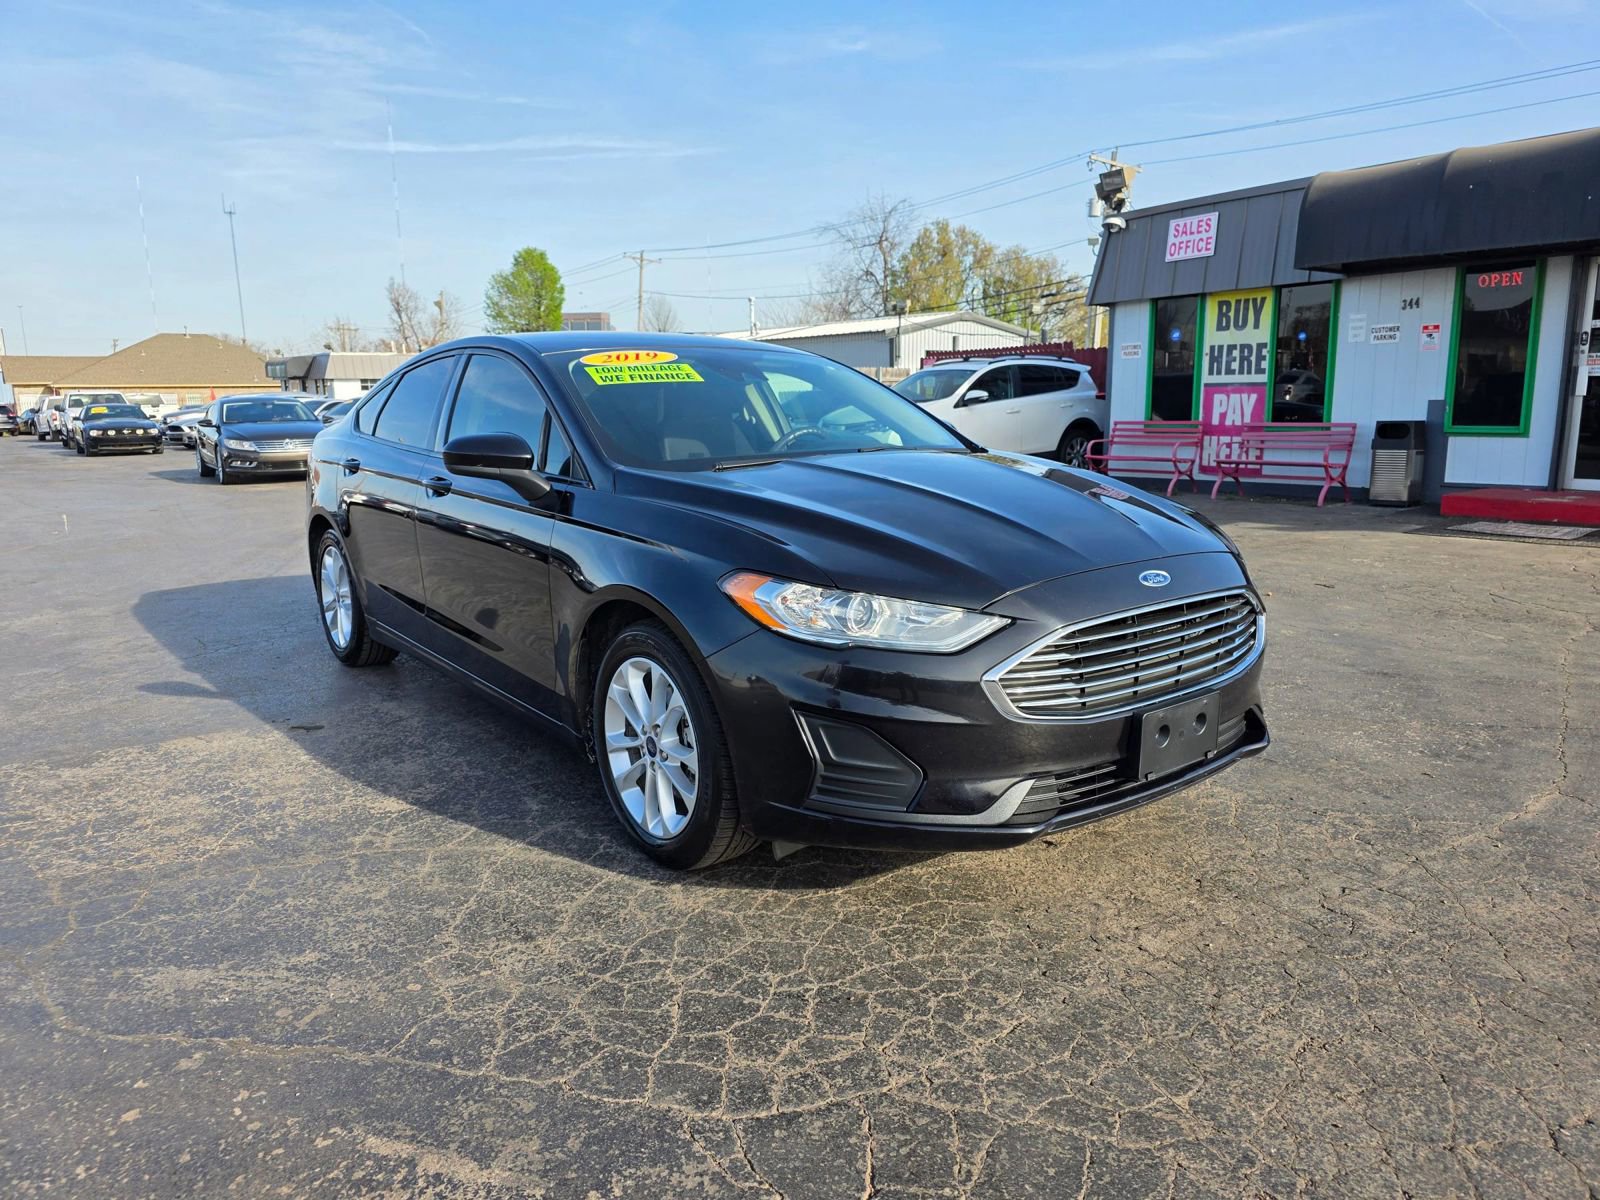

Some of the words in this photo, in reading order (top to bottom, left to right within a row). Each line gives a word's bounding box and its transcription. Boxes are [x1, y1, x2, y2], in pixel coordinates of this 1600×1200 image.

[1173, 217, 1212, 239] SALES
[1169, 236, 1213, 257] OFFICE
[1478, 271, 1524, 288] OPEN
[1401, 297, 1420, 311] 344
[1215, 296, 1268, 332] BUY
[1371, 326, 1400, 334] CUSTOMER
[601, 352, 658, 363] 2019
[1207, 342, 1268, 376] HERE
[595, 366, 623, 374] LOW
[627, 364, 686, 373] MILEAGE
[599, 375, 625, 383] WE
[630, 372, 696, 382] FINANCE
[1211, 393, 1258, 426] PAY
[1147, 573, 1165, 584] Ford
